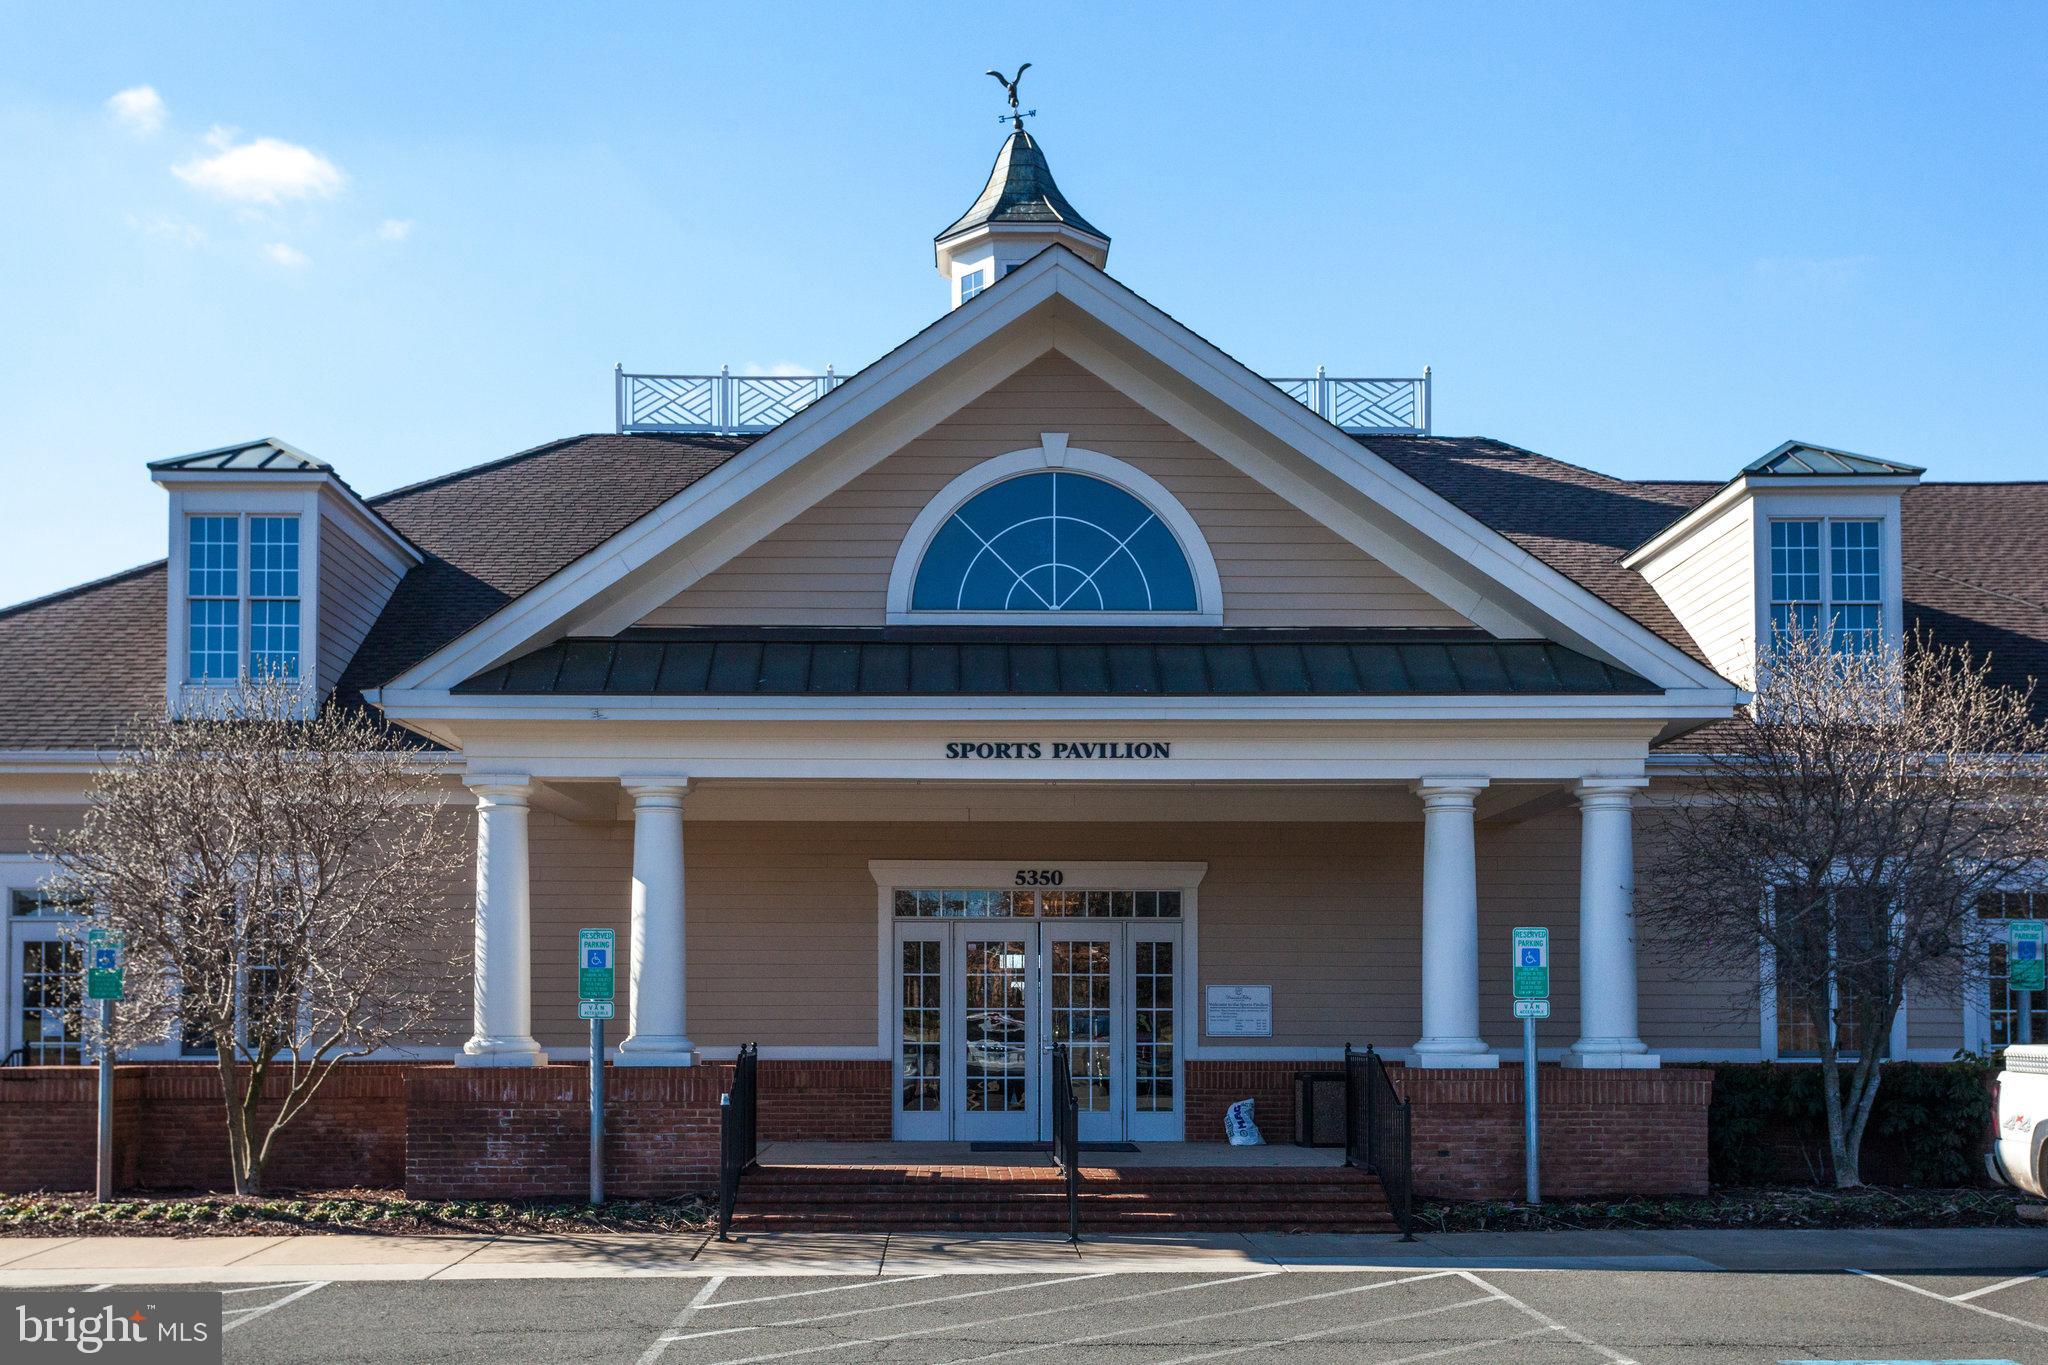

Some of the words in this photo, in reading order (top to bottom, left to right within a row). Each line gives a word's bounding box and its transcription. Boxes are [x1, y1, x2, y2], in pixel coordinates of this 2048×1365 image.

[946, 742, 1041, 759] SPORTS
[1052, 742, 1171, 759] PAVILION
[1015, 869, 1063, 886] 5350
